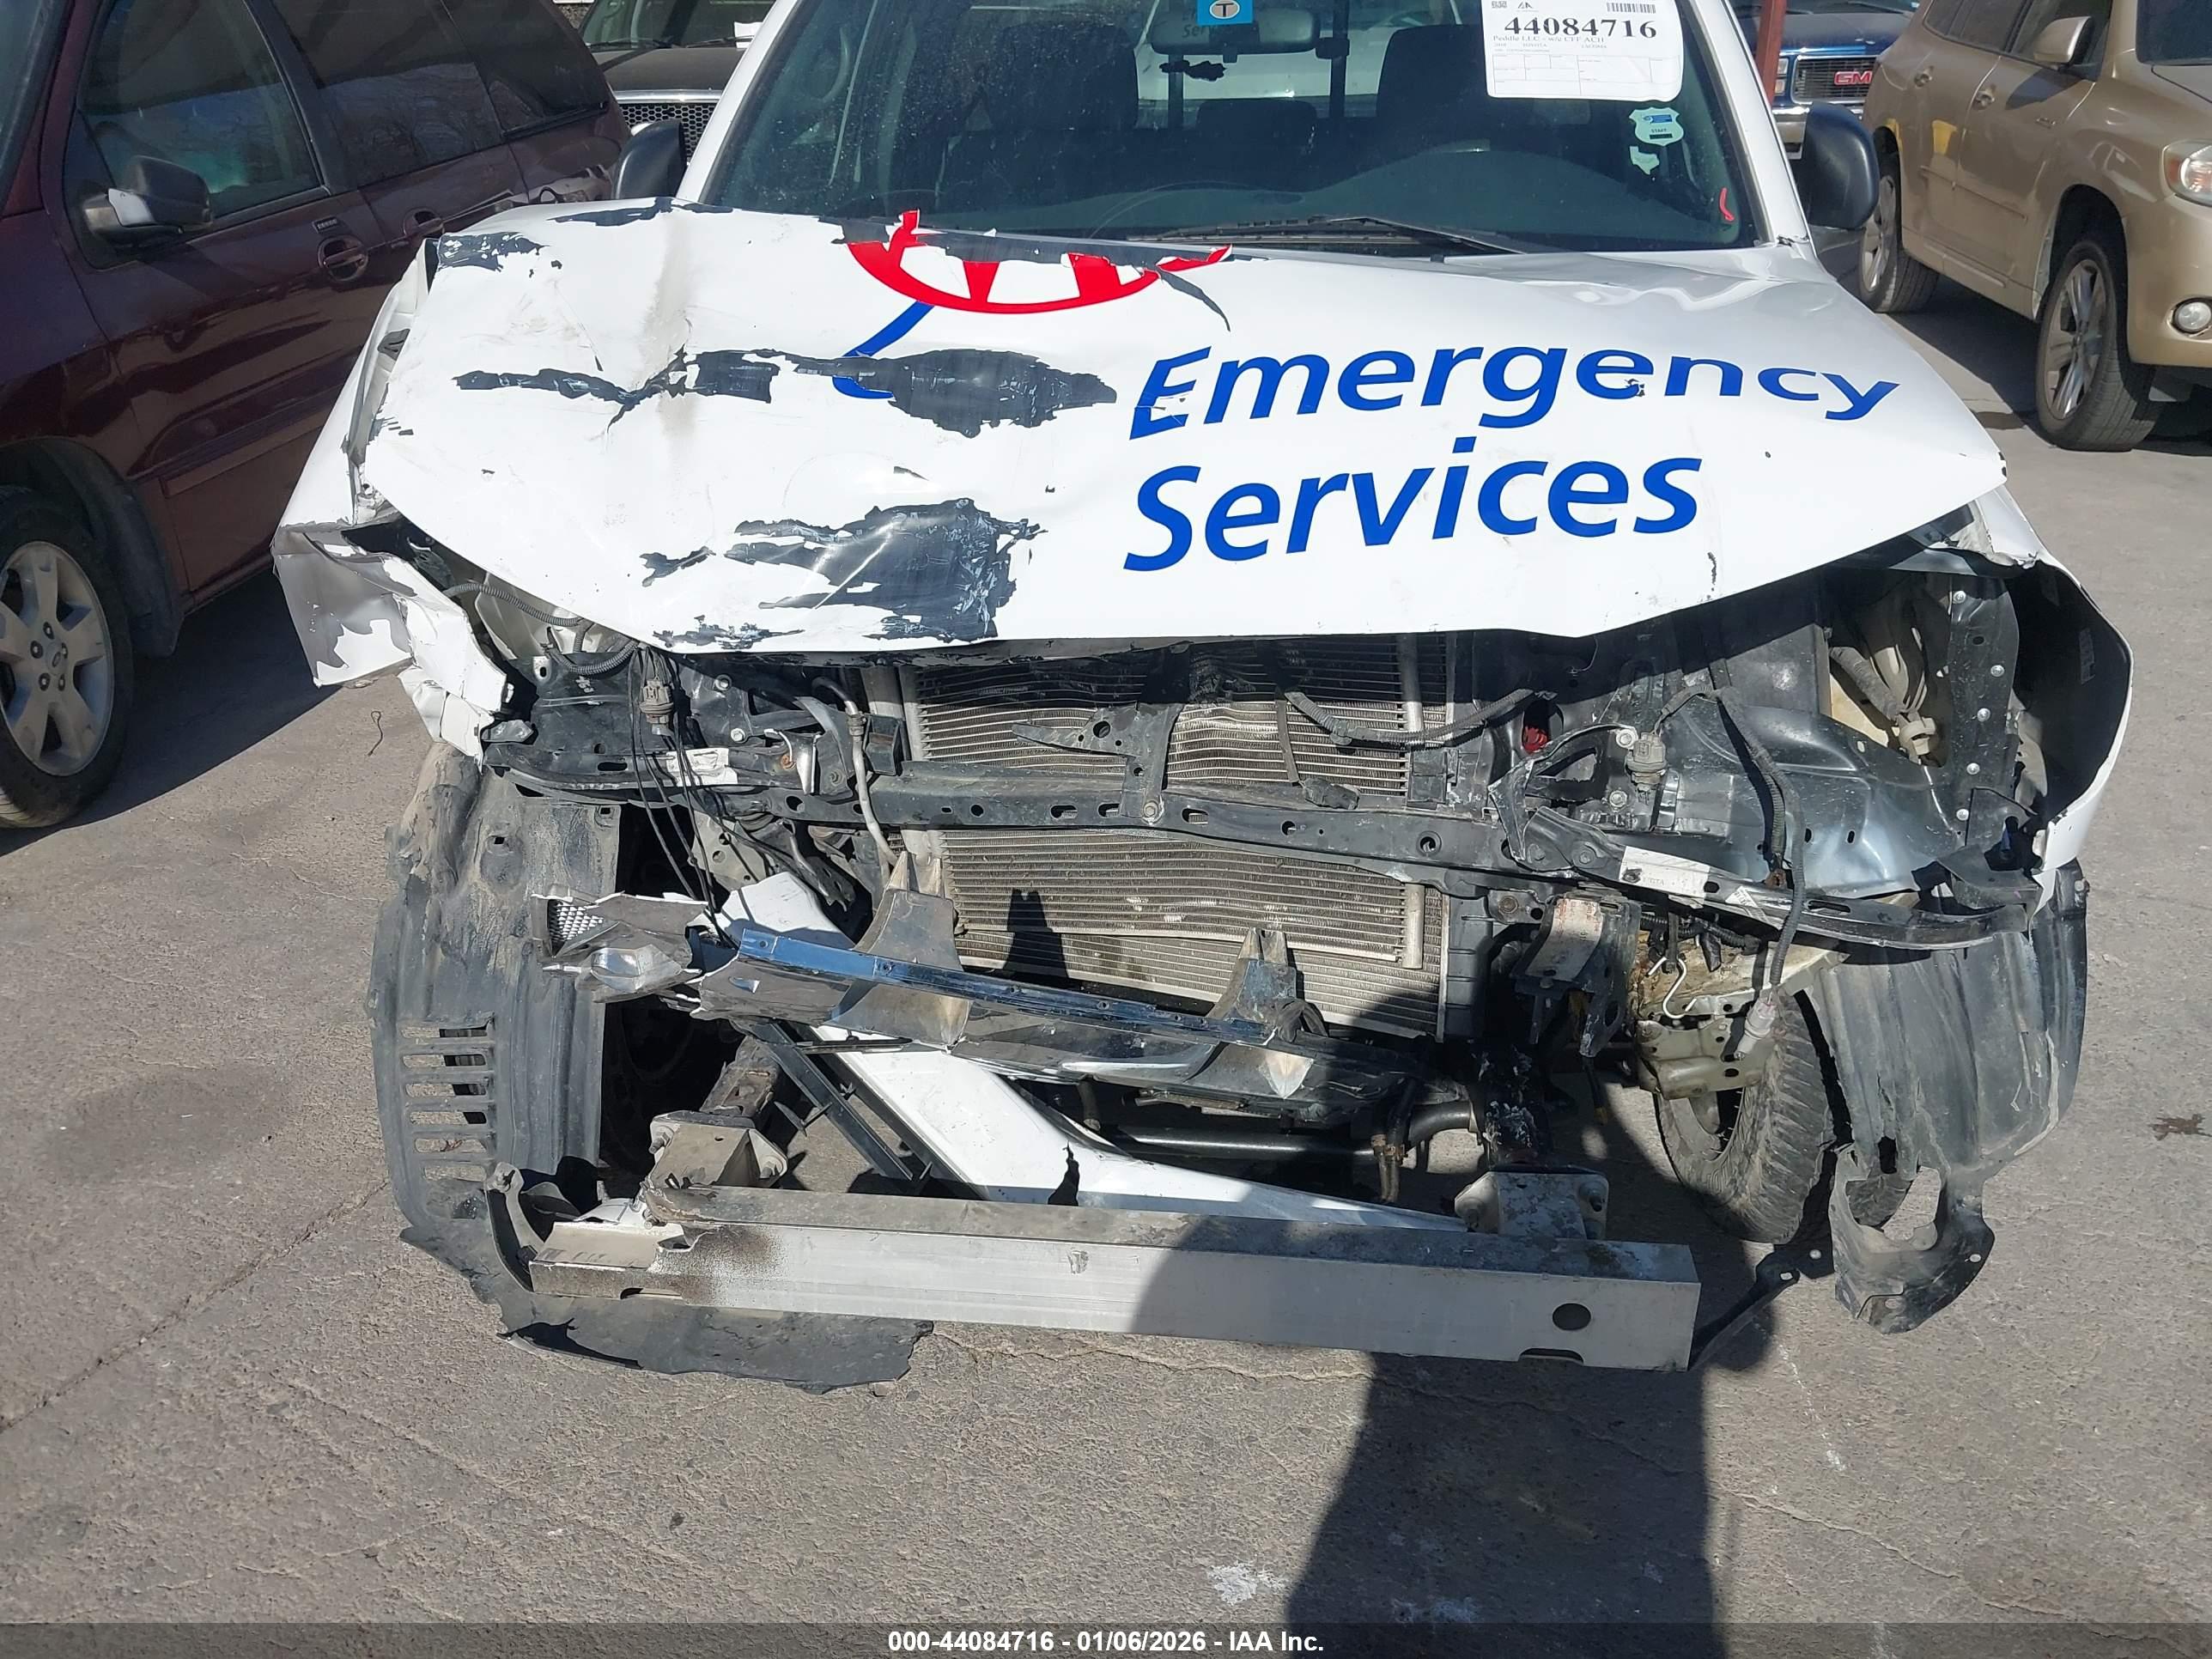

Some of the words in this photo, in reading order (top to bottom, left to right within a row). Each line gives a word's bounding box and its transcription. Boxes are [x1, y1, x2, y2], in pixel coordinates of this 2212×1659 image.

[1504, 16, 1657, 39] 44084716
[1834, 71, 1873, 85] GM
[1129, 344, 1900, 441] Emergency
[1123, 435, 1702, 572] Services
